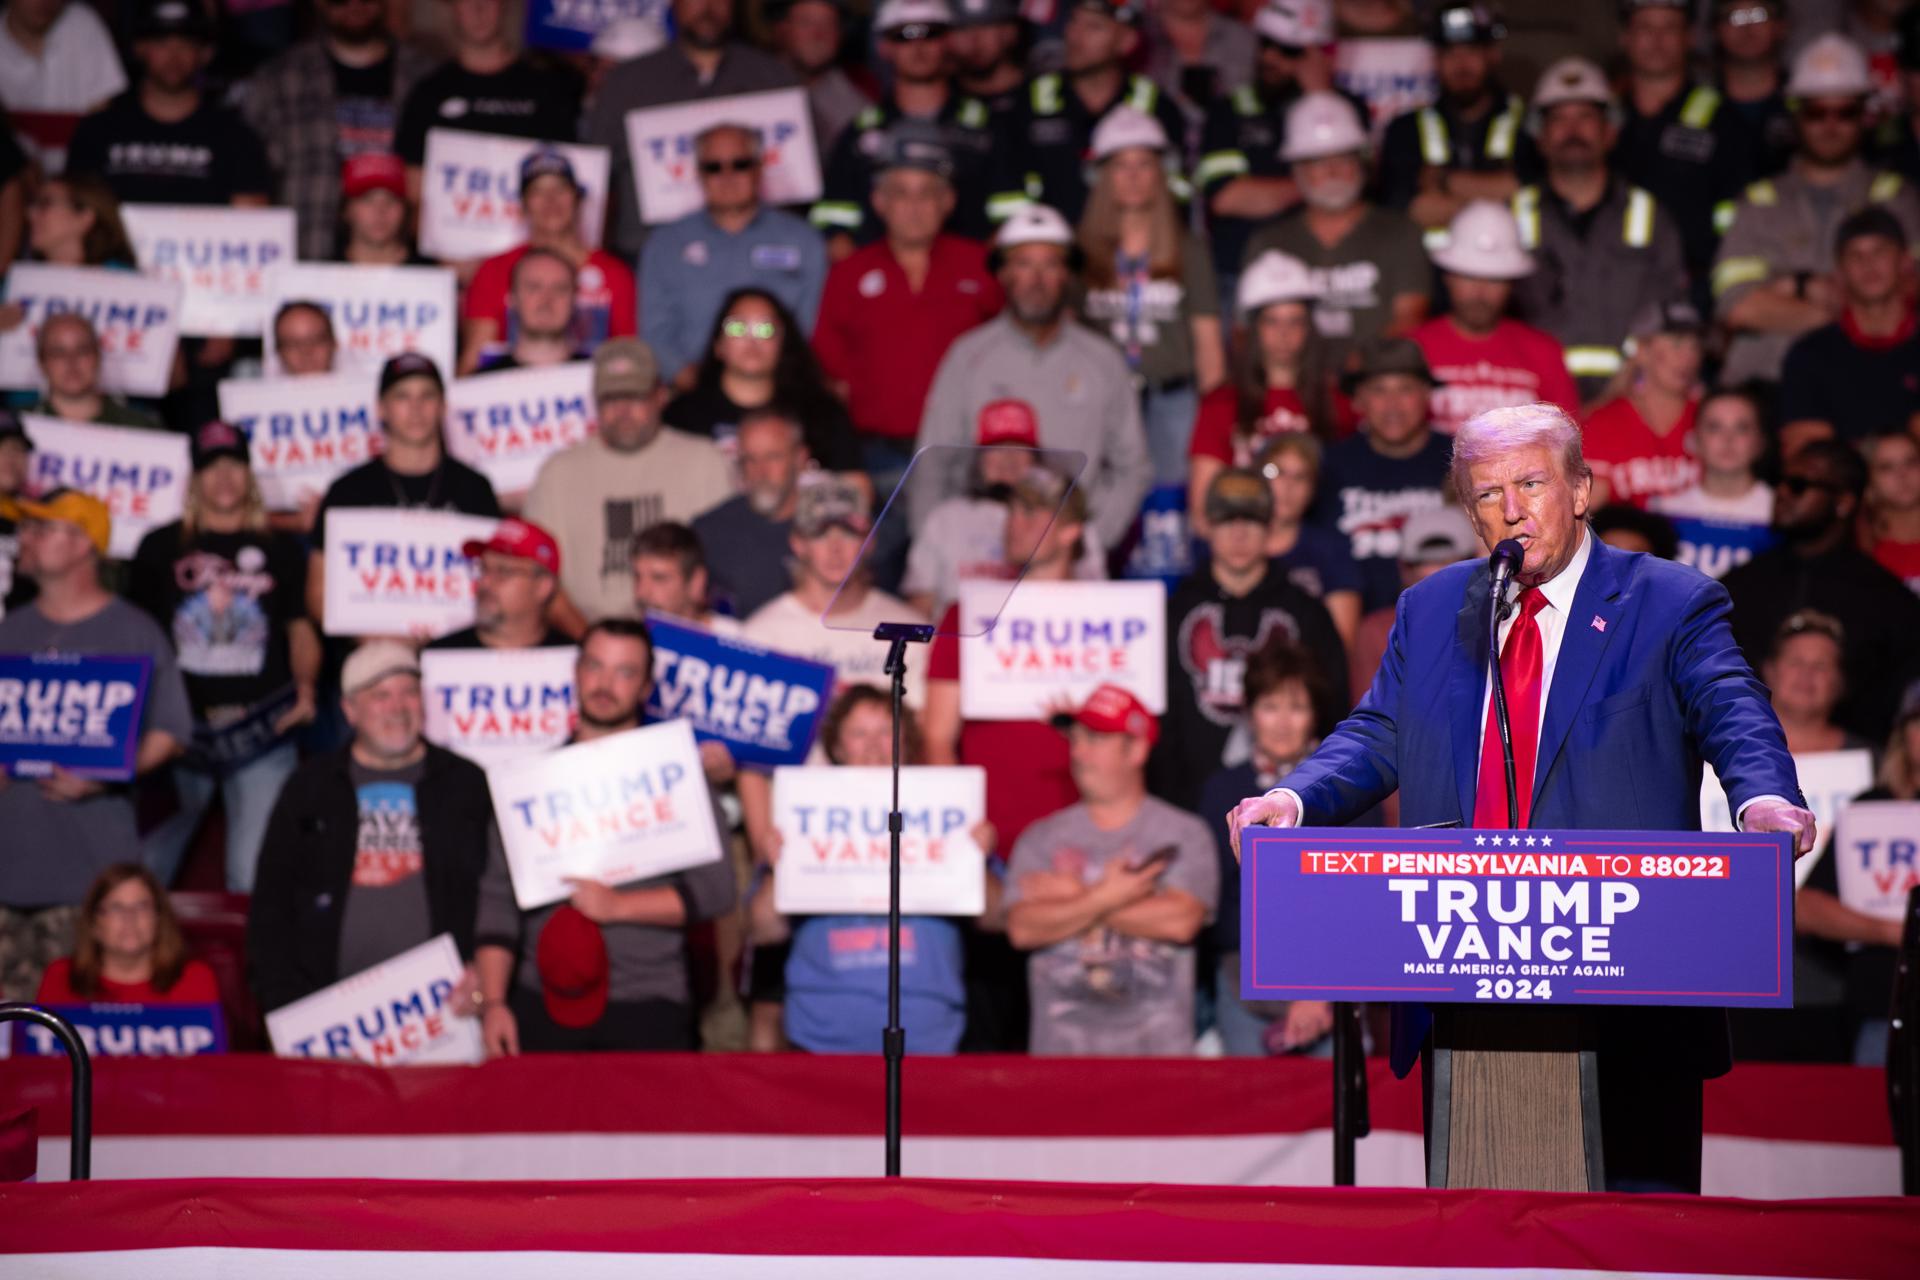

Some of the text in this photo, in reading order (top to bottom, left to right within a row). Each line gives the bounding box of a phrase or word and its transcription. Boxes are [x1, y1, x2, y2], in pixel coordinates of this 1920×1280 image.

[650, 122, 796, 160] TRP
[234, 404, 384, 442] TRUM
[459, 397, 587, 433] TRUM
[38, 453, 174, 489] RUMP
[343, 542, 477, 569] TRUM
[978, 618, 1148, 646] TRUMP
[997, 649, 1131, 673] VANCE
[0, 678, 136, 710] RUMP
[437, 683, 576, 711] TRUM
[653, 645, 819, 717] TRUMP
[0, 705, 113, 737] ANCE
[656, 680, 793, 743] VANCE
[512, 762, 685, 828] TRUMP
[539, 796, 674, 848] VANCE
[793, 805, 966, 836] TRUMP
[812, 841, 945, 864] VANCE
[1308, 852, 1723, 877] TEXT PENNSYLVANIA TO 88022
[1388, 879, 1640, 925] TRUMP
[1416, 924, 1611, 962] VANCE
[1404, 963, 1625, 977] MAKE AMERICA GREAT AGAIN!
[1475, 979, 1552, 1000] 2024
[293, 978, 455, 1058] TRUMP
